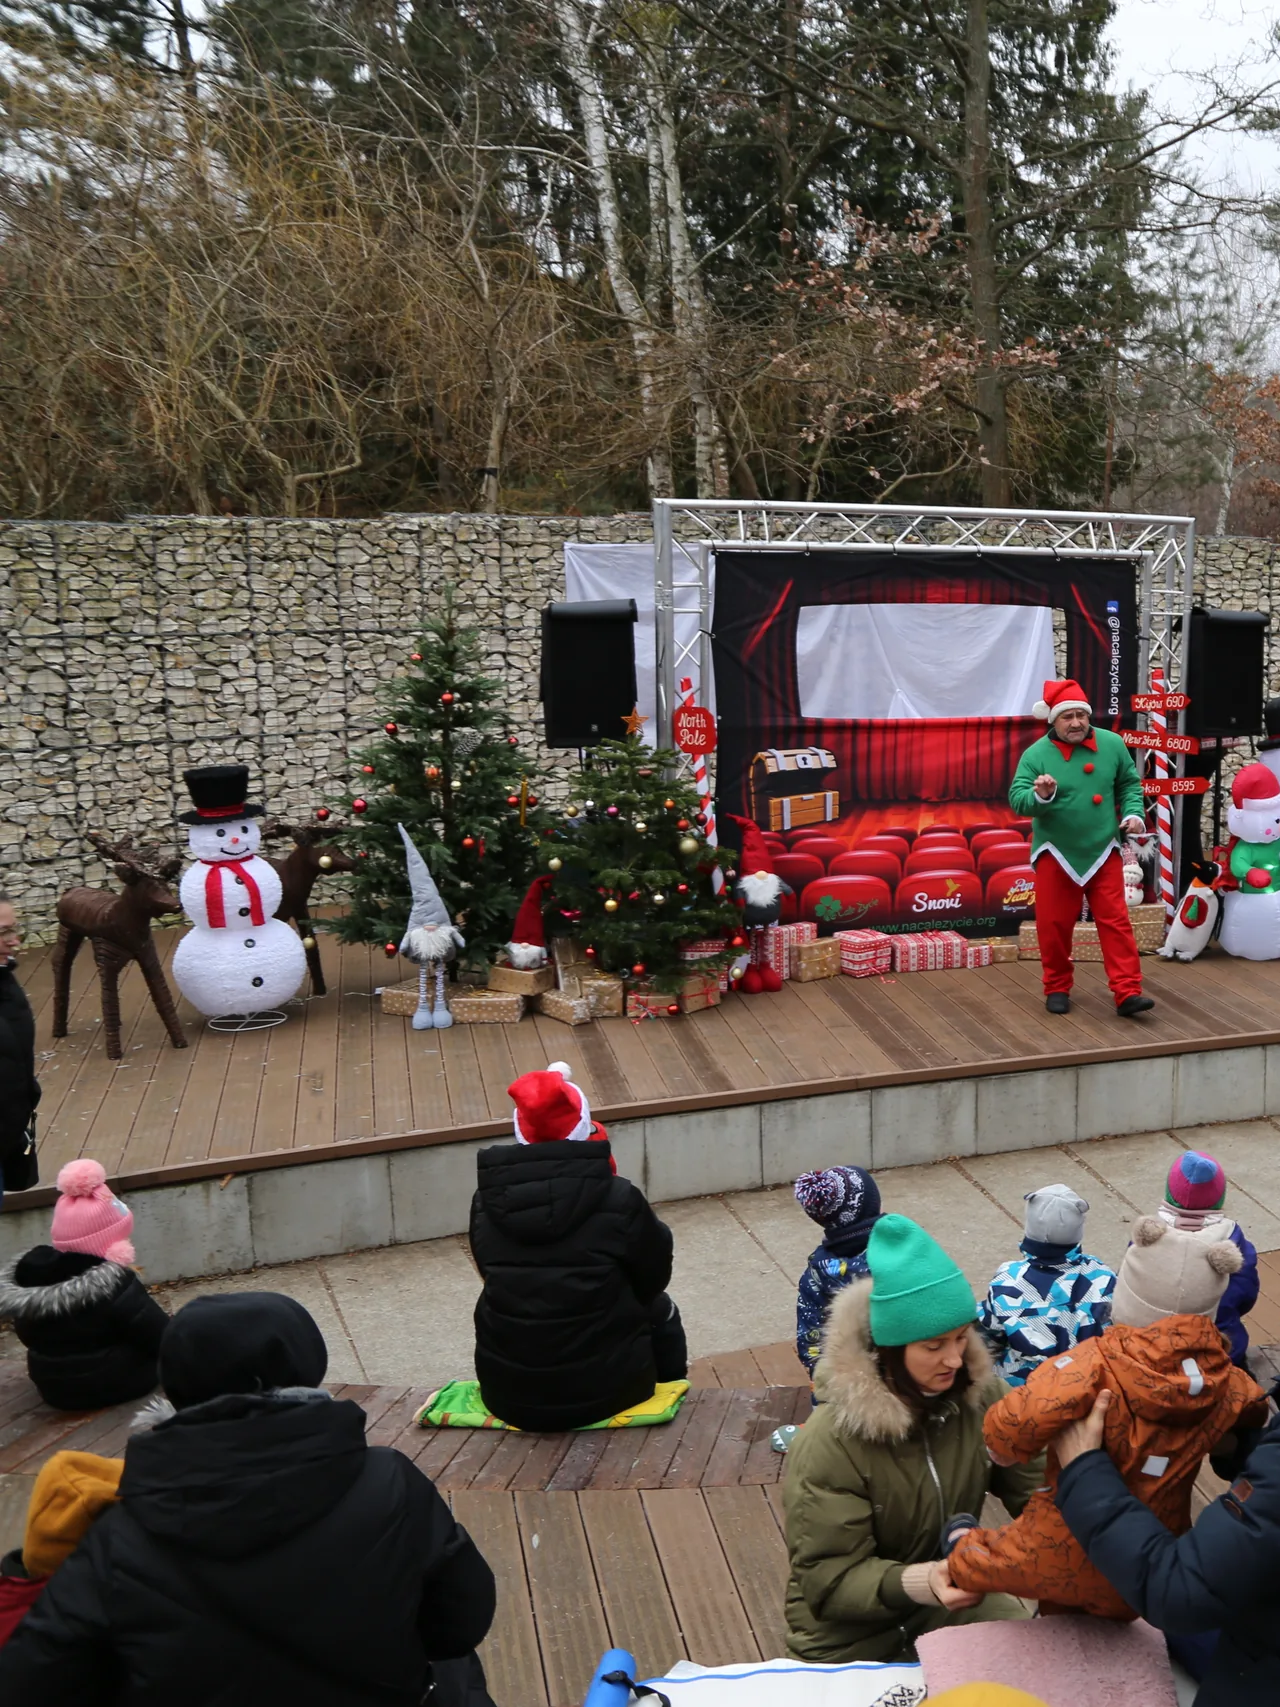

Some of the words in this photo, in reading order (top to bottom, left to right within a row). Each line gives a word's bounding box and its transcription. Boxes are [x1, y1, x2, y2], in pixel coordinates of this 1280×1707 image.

[1107, 616, 1121, 715] @nacalezycie.org
[1166, 695, 1185, 708] 690
[678, 712, 707, 728] North
[680, 728, 707, 747] Pole
[1122, 732, 1142, 745] New
[1141, 734, 1163, 748] York
[1166, 737, 1192, 751] 6800
[1144, 782, 1161, 794] kio
[1172, 780, 1195, 792] 8595
[912, 892, 962, 912] Snovi
